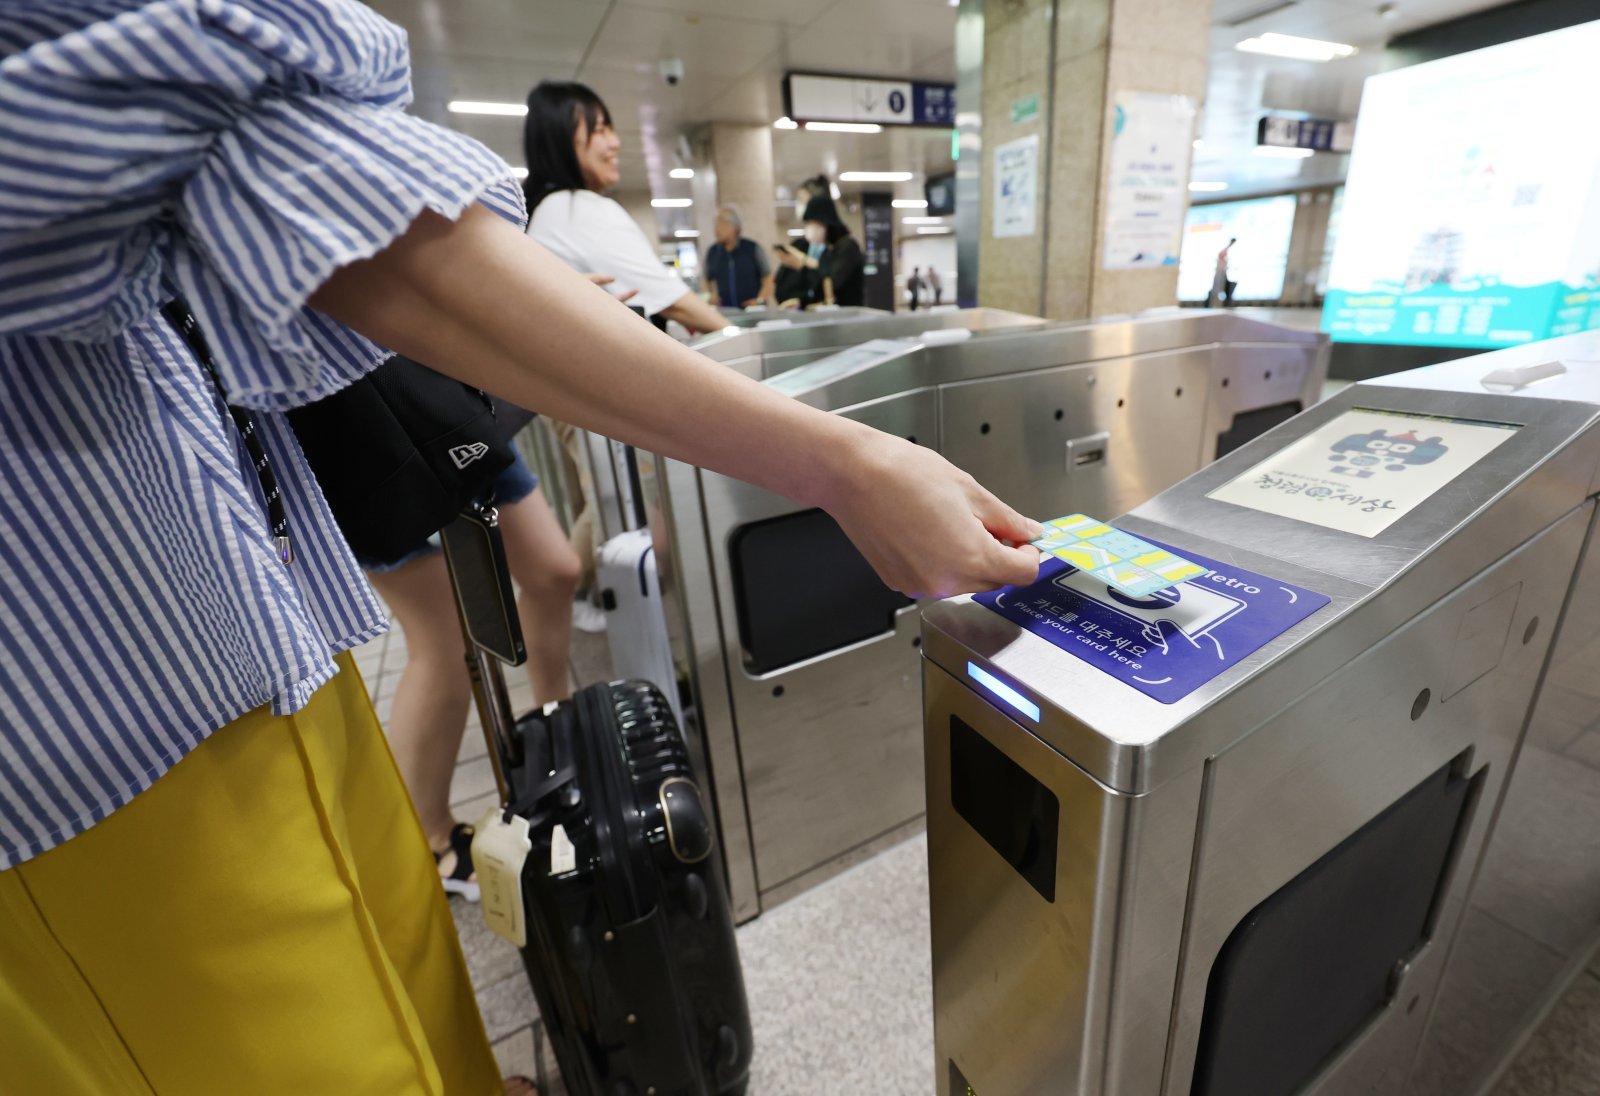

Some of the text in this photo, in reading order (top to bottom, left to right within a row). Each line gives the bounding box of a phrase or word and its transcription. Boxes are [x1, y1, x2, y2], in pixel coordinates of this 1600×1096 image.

[1014, 602, 1142, 670] Place your card here
[1033, 598, 1147, 658] 카드를 대주세요
